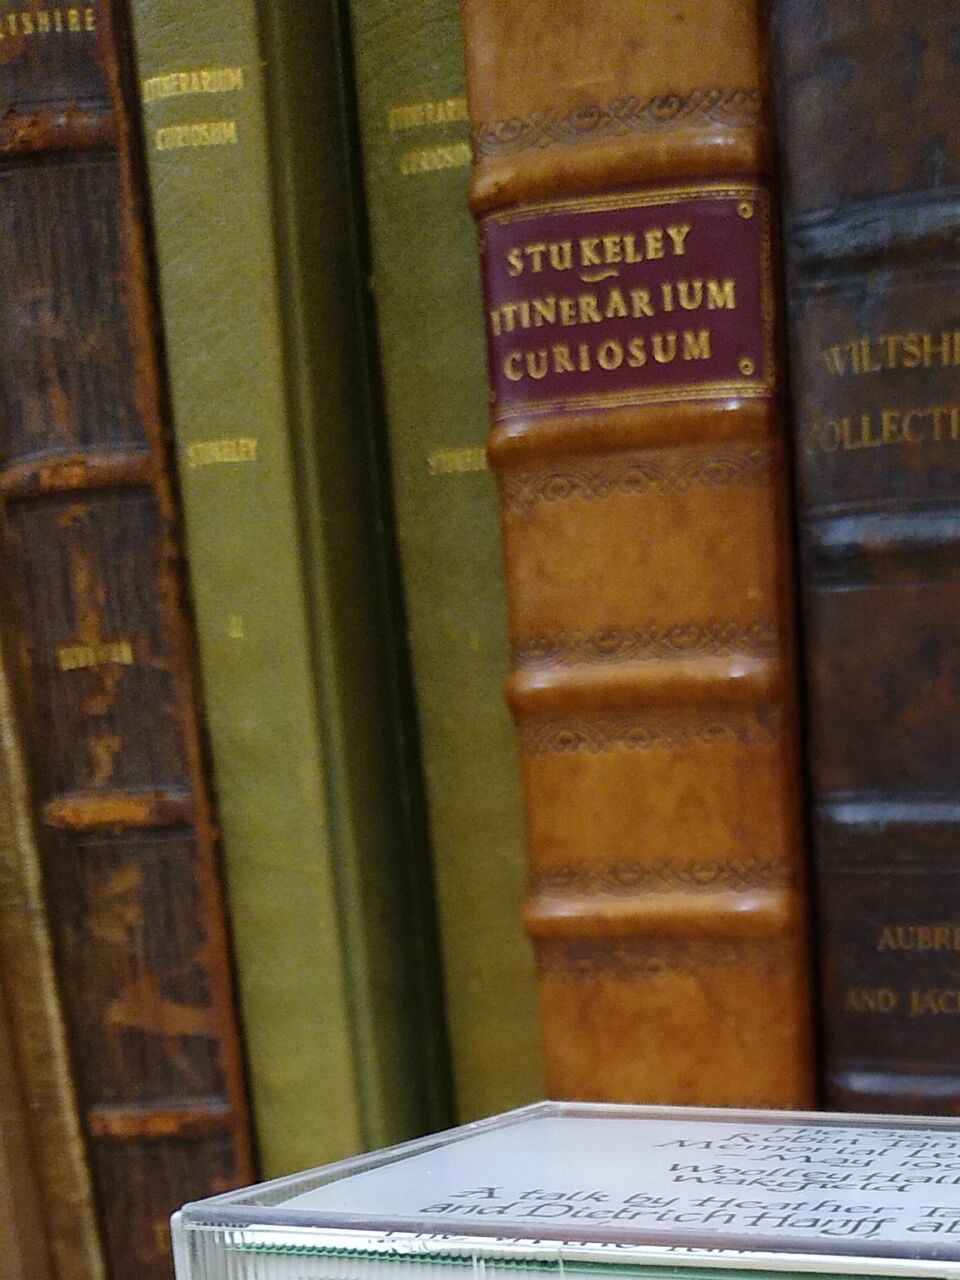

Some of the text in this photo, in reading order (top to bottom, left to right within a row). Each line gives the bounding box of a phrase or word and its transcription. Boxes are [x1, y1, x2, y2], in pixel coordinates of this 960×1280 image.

[0, 8, 96, 40] TSHIRE
[507, 225, 692, 277] STUKELEY
[491, 280, 736, 336] ITINERARIUM
[504, 329, 711, 381] CURIOSUM
[653, 1140, 897, 1156] Memorial
[720, 1132, 861, 1145] Robin
[669, 1163, 854, 1184] Woolley
[749, 1155, 875, 1168] May
[672, 1175, 912, 1193] Wakefield
[449, 1186, 503, 1200] A
[519, 1189, 610, 1203] talk
[622, 1192, 681, 1208] by
[689, 1196, 905, 1214] Heather
[418, 1201, 521, 1215] and
[516, 1201, 737, 1225] Dietrich
